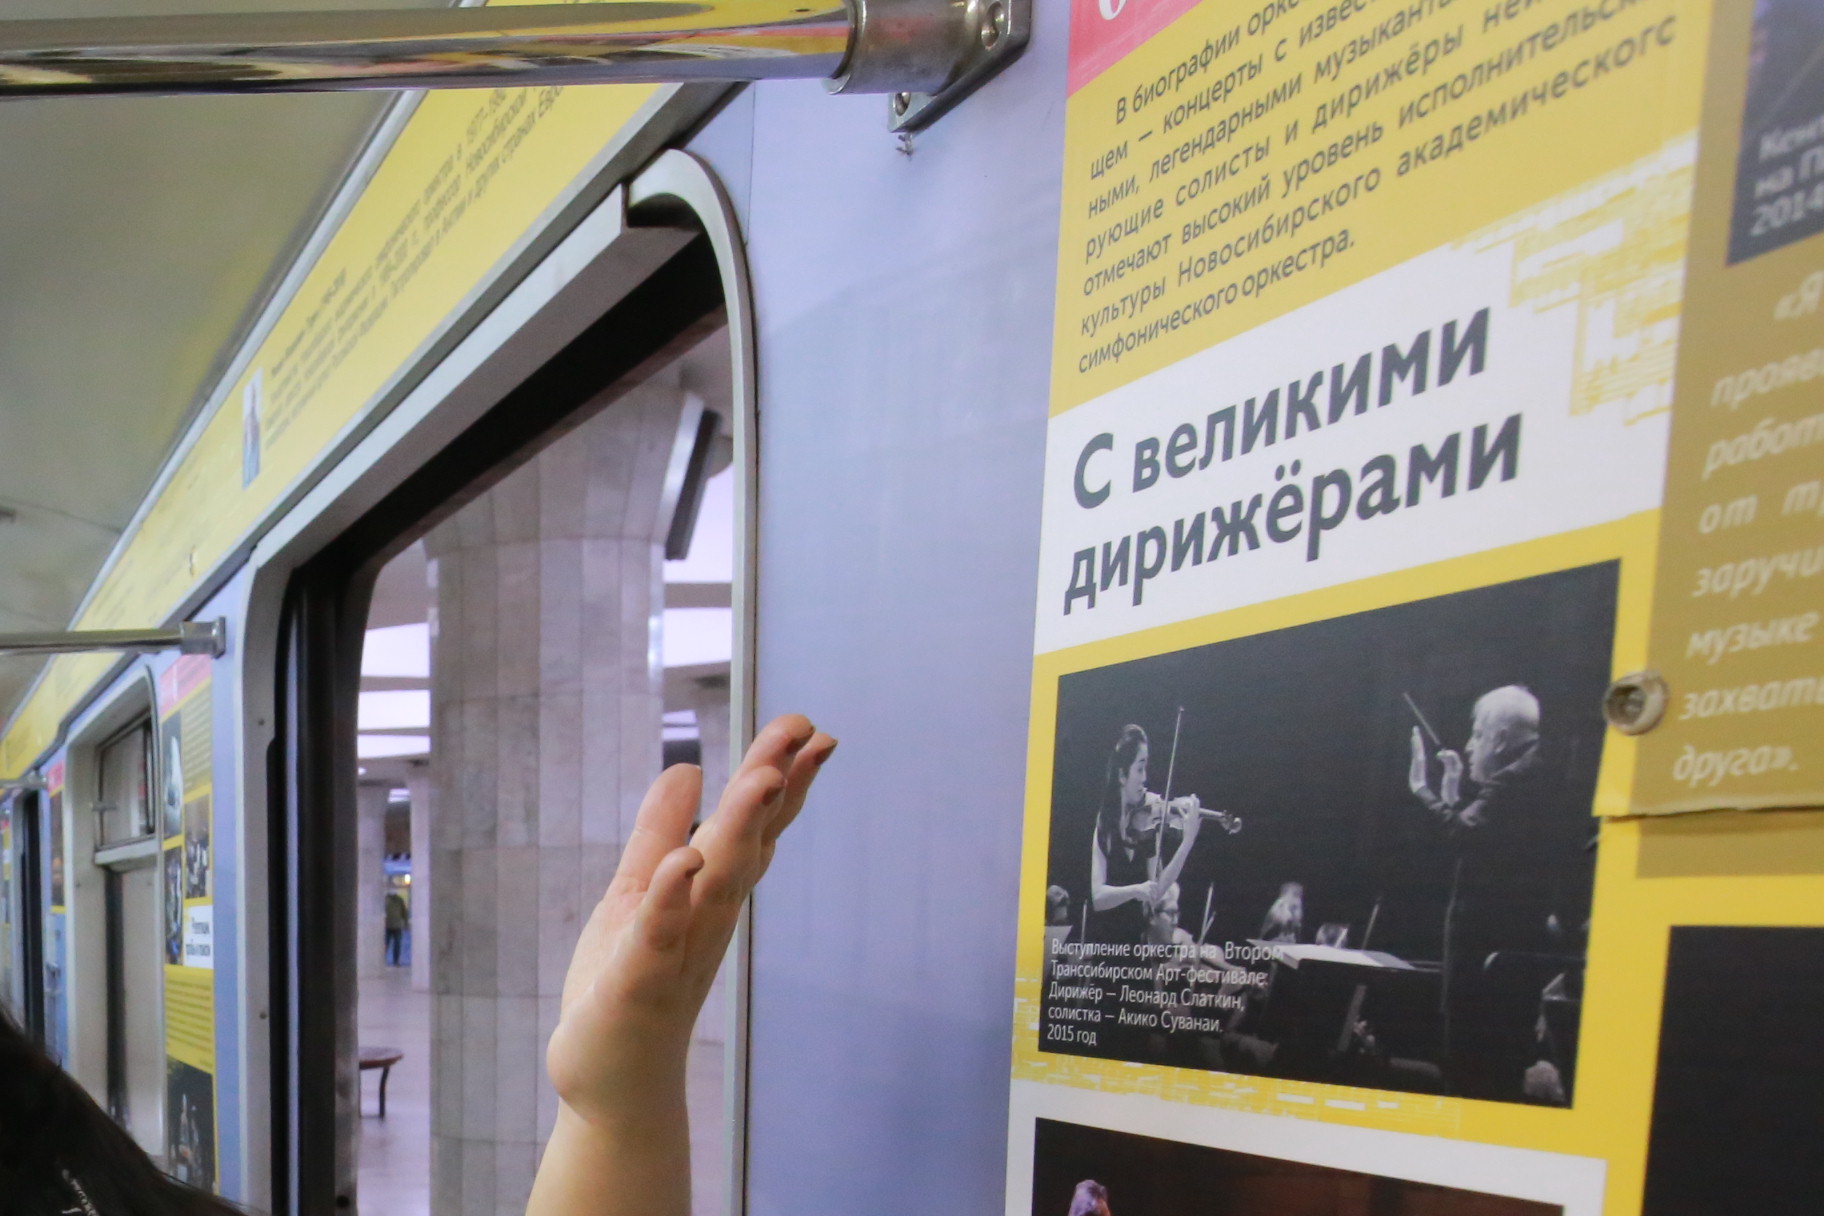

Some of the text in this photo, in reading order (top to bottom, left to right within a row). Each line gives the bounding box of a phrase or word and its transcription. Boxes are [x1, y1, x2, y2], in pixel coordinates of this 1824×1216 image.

[1091, 141, 1128, 181] щем
[1162, 53, 1263, 135] концерты
[1274, 37, 1288, 62] с
[1116, 97, 1127, 125] В
[1133, 25, 1240, 114] биографии
[1085, 198, 1165, 266] рующие
[1175, 136, 1271, 208] солисты
[1284, 119, 1298, 147] и
[1313, 24, 1464, 134] дирижёры
[1088, 175, 1140, 220] ными,
[1148, 72, 1303, 184] легендарными
[1080, 276, 1166, 337] культуры
[1177, 166, 1382, 288] Новосибирского
[1082, 232, 1173, 297] отмечают
[1181, 174, 1271, 246] высокий
[1281, 120, 1385, 200] уровень
[1078, 228, 1356, 375] симфонического оркестра.
[1074, 306, 1491, 510] С великими
[1063, 411, 1524, 617] дирижёрами
[1684, 610, 1820, 666] музыке
[1672, 744, 1799, 788] друга».
[1048, 981, 1104, 1004] Дирижёр
[1119, 984, 1178, 1009] Леонард
[1180, 987, 1246, 1013] Слаткин,
[1050, 959, 1154, 981] Транссибирском
[1051, 938, 1284, 965] Выступление оркестра на Втором
[1047, 1023, 1098, 1047] 2015 год
[1048, 1005, 1102, 1023] солистка
[1117, 1008, 1158, 1028] Акико
[1160, 1010, 1225, 1034] Суванаи.
